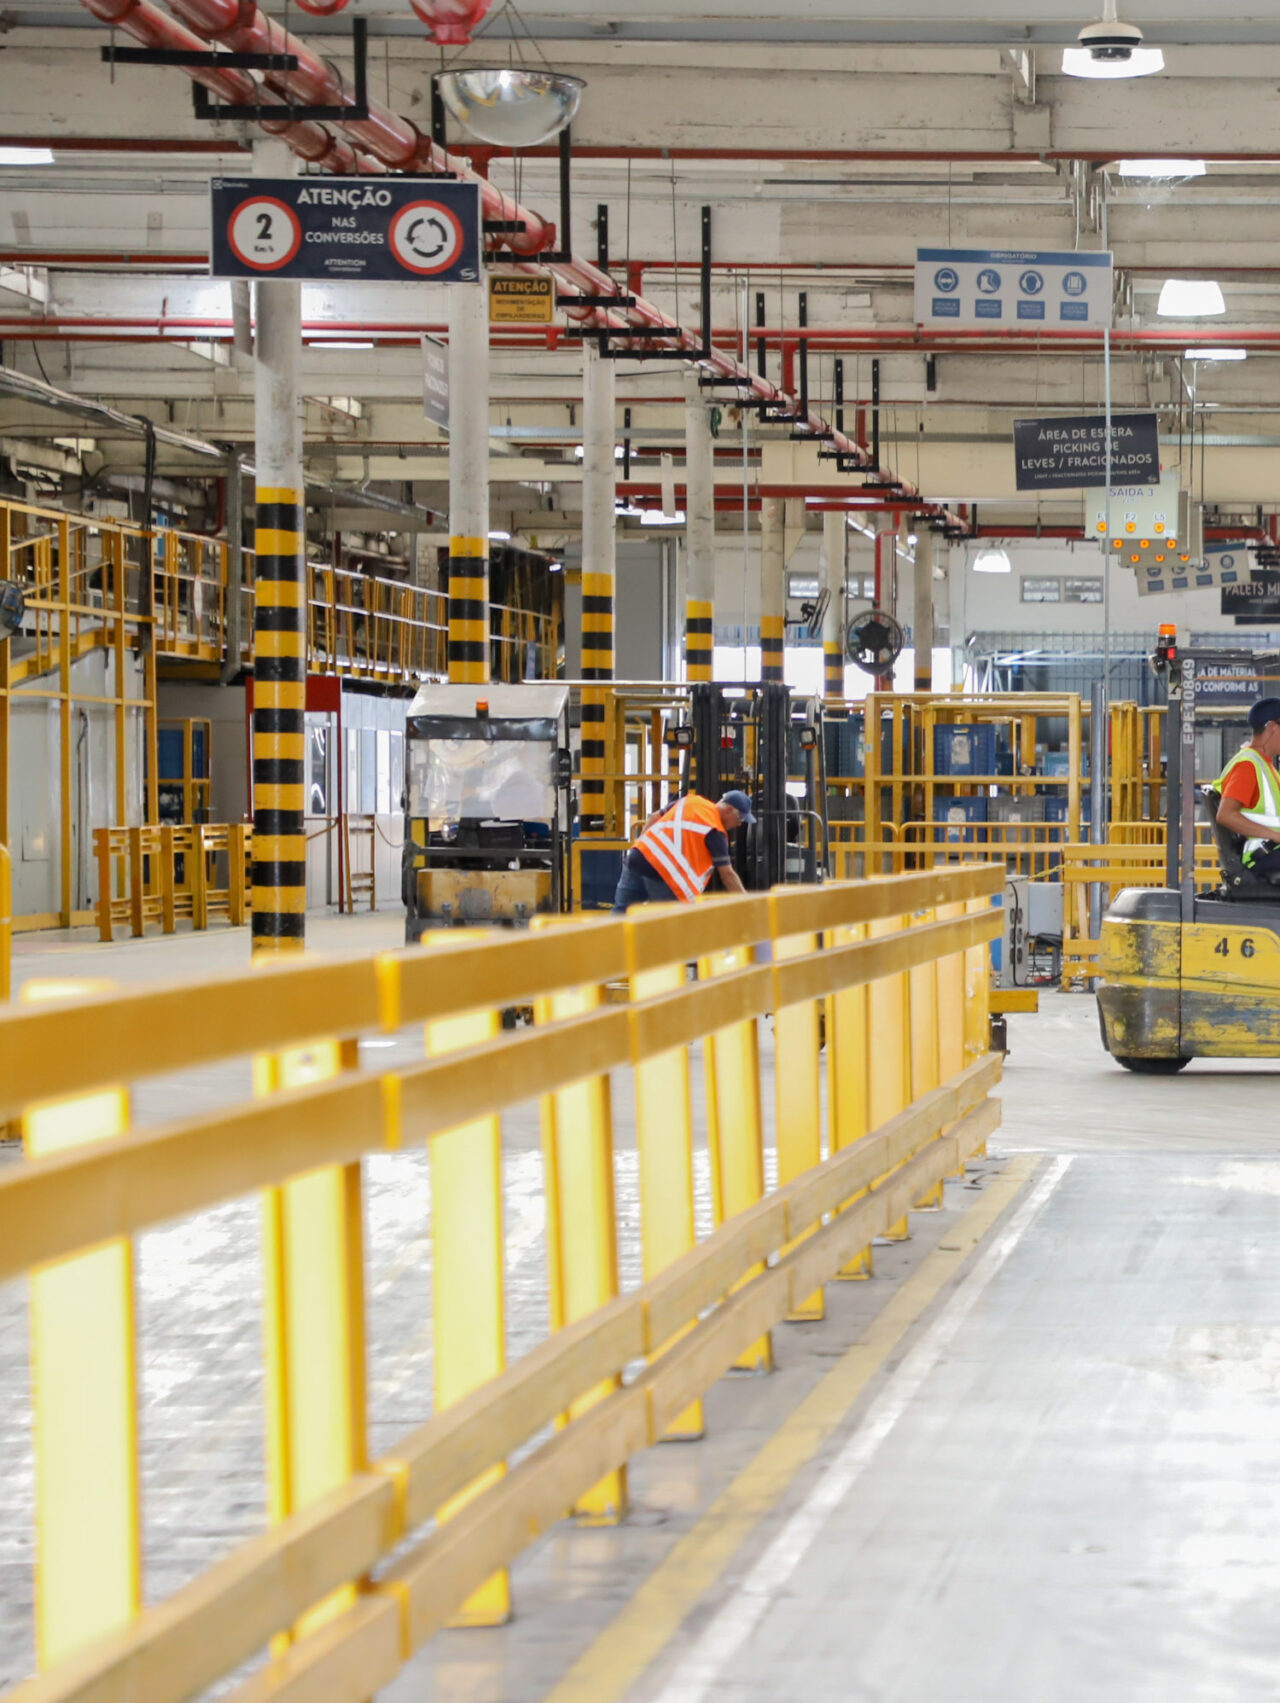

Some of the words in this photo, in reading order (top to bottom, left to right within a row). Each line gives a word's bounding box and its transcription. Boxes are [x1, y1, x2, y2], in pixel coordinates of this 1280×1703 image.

[296, 186, 392, 210] ATENÇÃO
[256, 213, 273, 240] 2
[331, 216, 357, 228] NAS
[305, 230, 385, 244] CONVERSÕES
[493, 280, 549, 294] ATENÇÃO
[1038, 428, 1069, 441] ÁREA
[1071, 428, 1087, 439] DE
[1053, 441, 1101, 454] PICKING
[1021, 458, 1056, 470] LEVES
[1058, 457, 1064, 469] /
[1202, 681, 1246, 693] CONFORME
[1182, 658, 1195, 744] EPE10849
